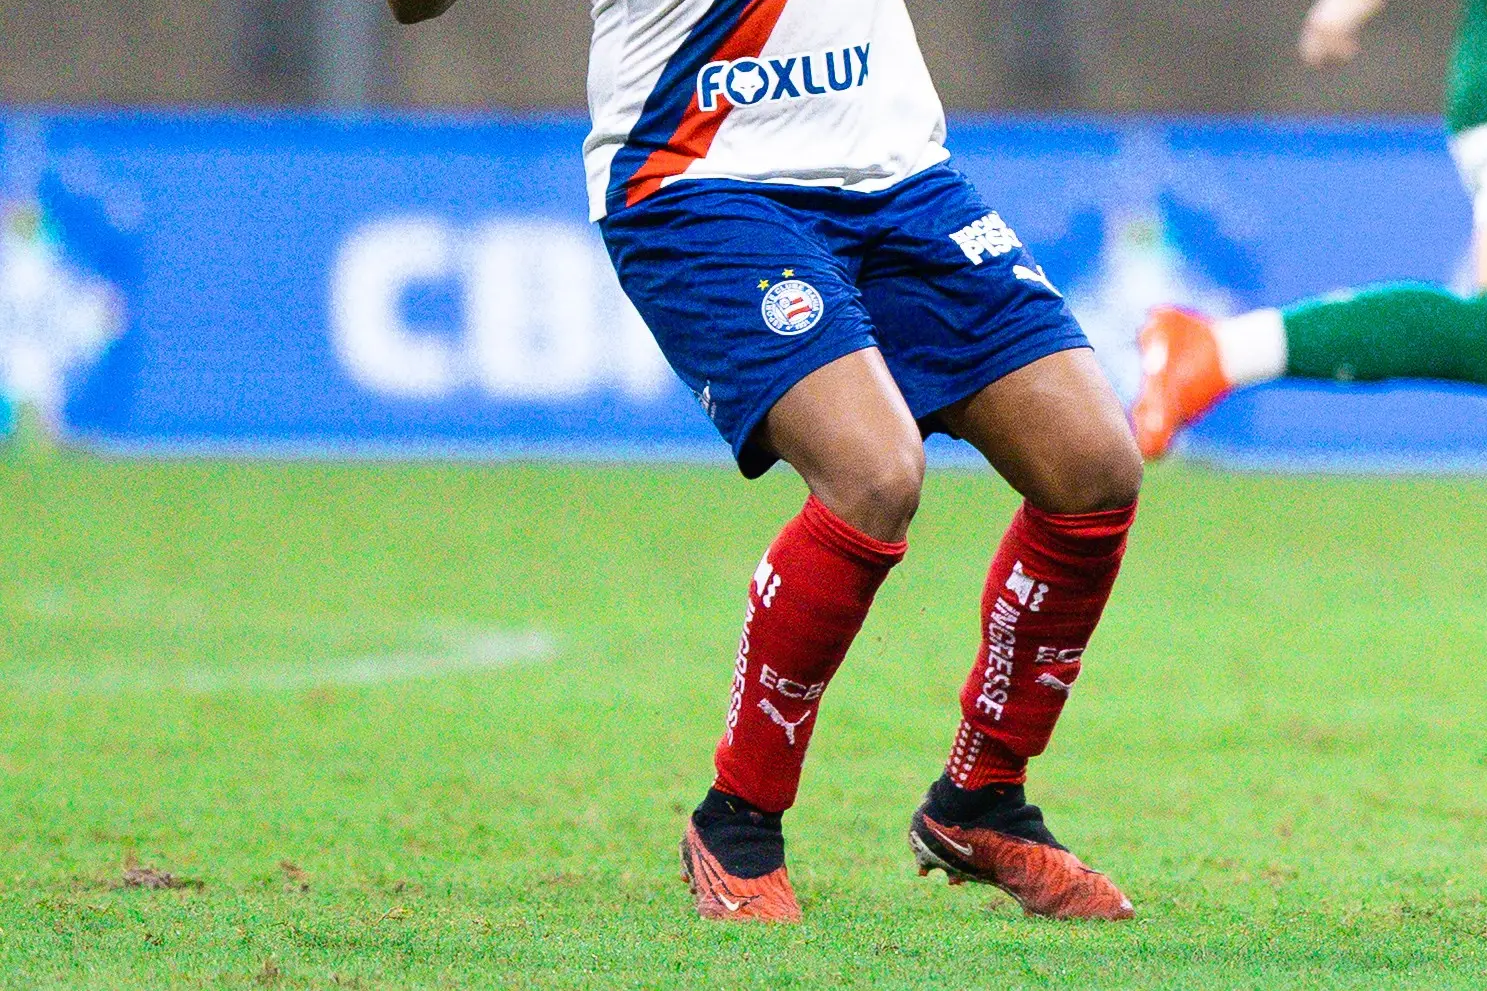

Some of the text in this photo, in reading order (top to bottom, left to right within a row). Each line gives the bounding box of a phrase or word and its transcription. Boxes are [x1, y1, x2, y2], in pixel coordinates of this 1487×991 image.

[701, 42, 870, 108] FOXLUX
[759, 663, 825, 701] ECB
[976, 596, 1021, 722] INGRESSE
